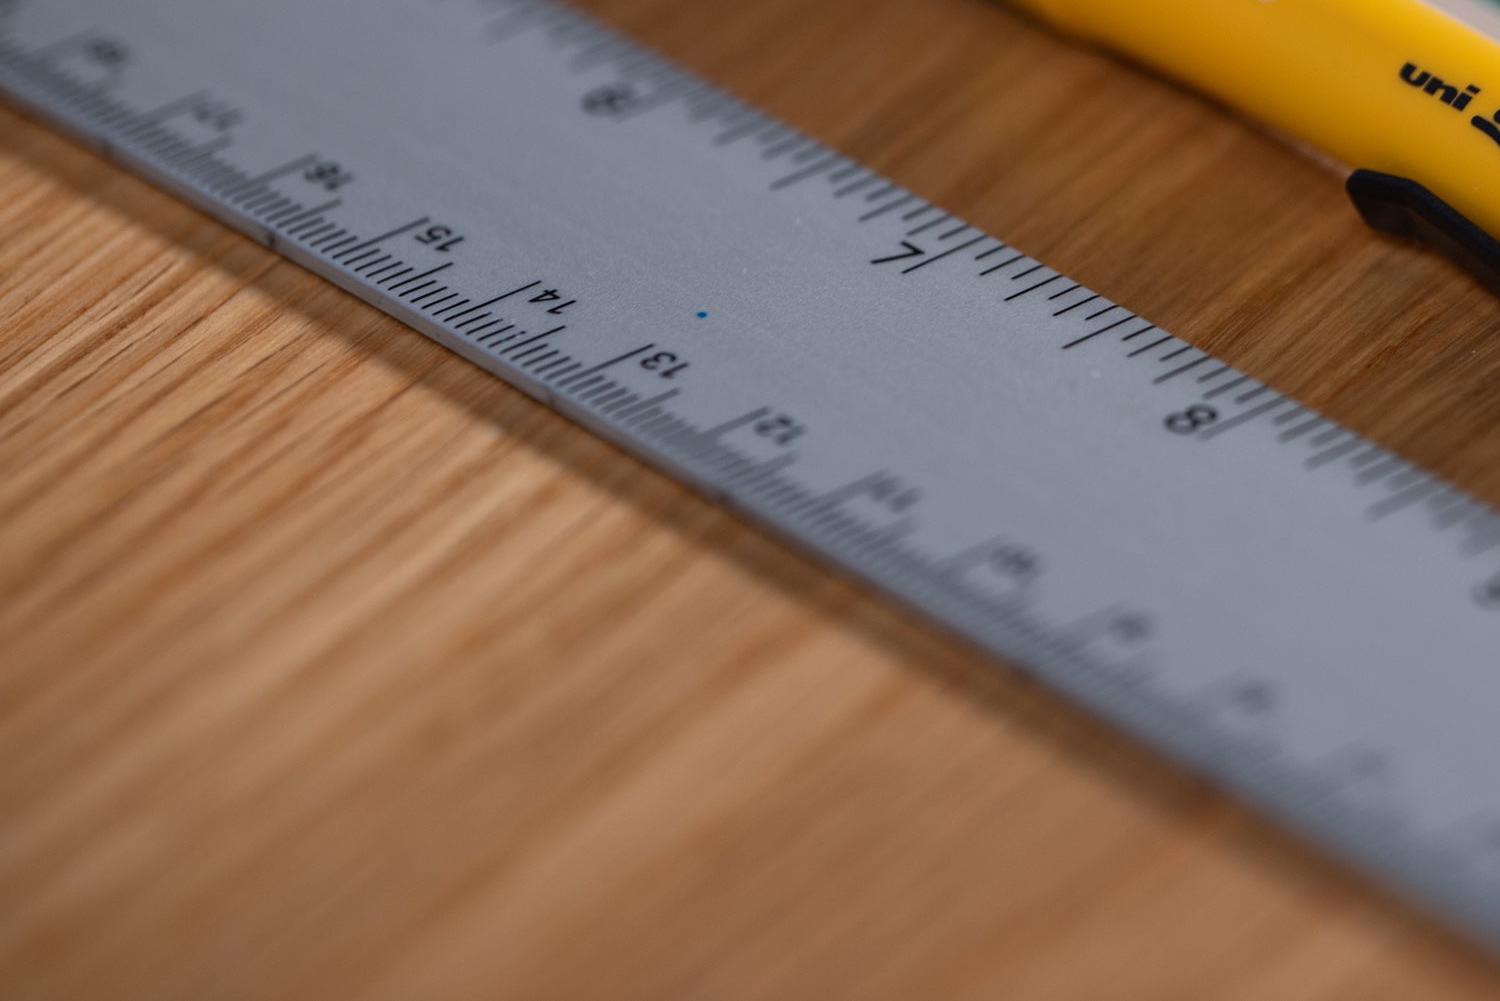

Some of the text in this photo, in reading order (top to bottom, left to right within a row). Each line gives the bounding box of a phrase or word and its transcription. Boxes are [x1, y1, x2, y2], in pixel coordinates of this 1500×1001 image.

[1400, 62, 1481, 112] uni
[414, 224, 465, 253] 15
[870, 240, 925, 265] 7
[528, 288, 577, 315] 14
[640, 351, 691, 380] 13
[1163, 403, 1219, 436] 8
